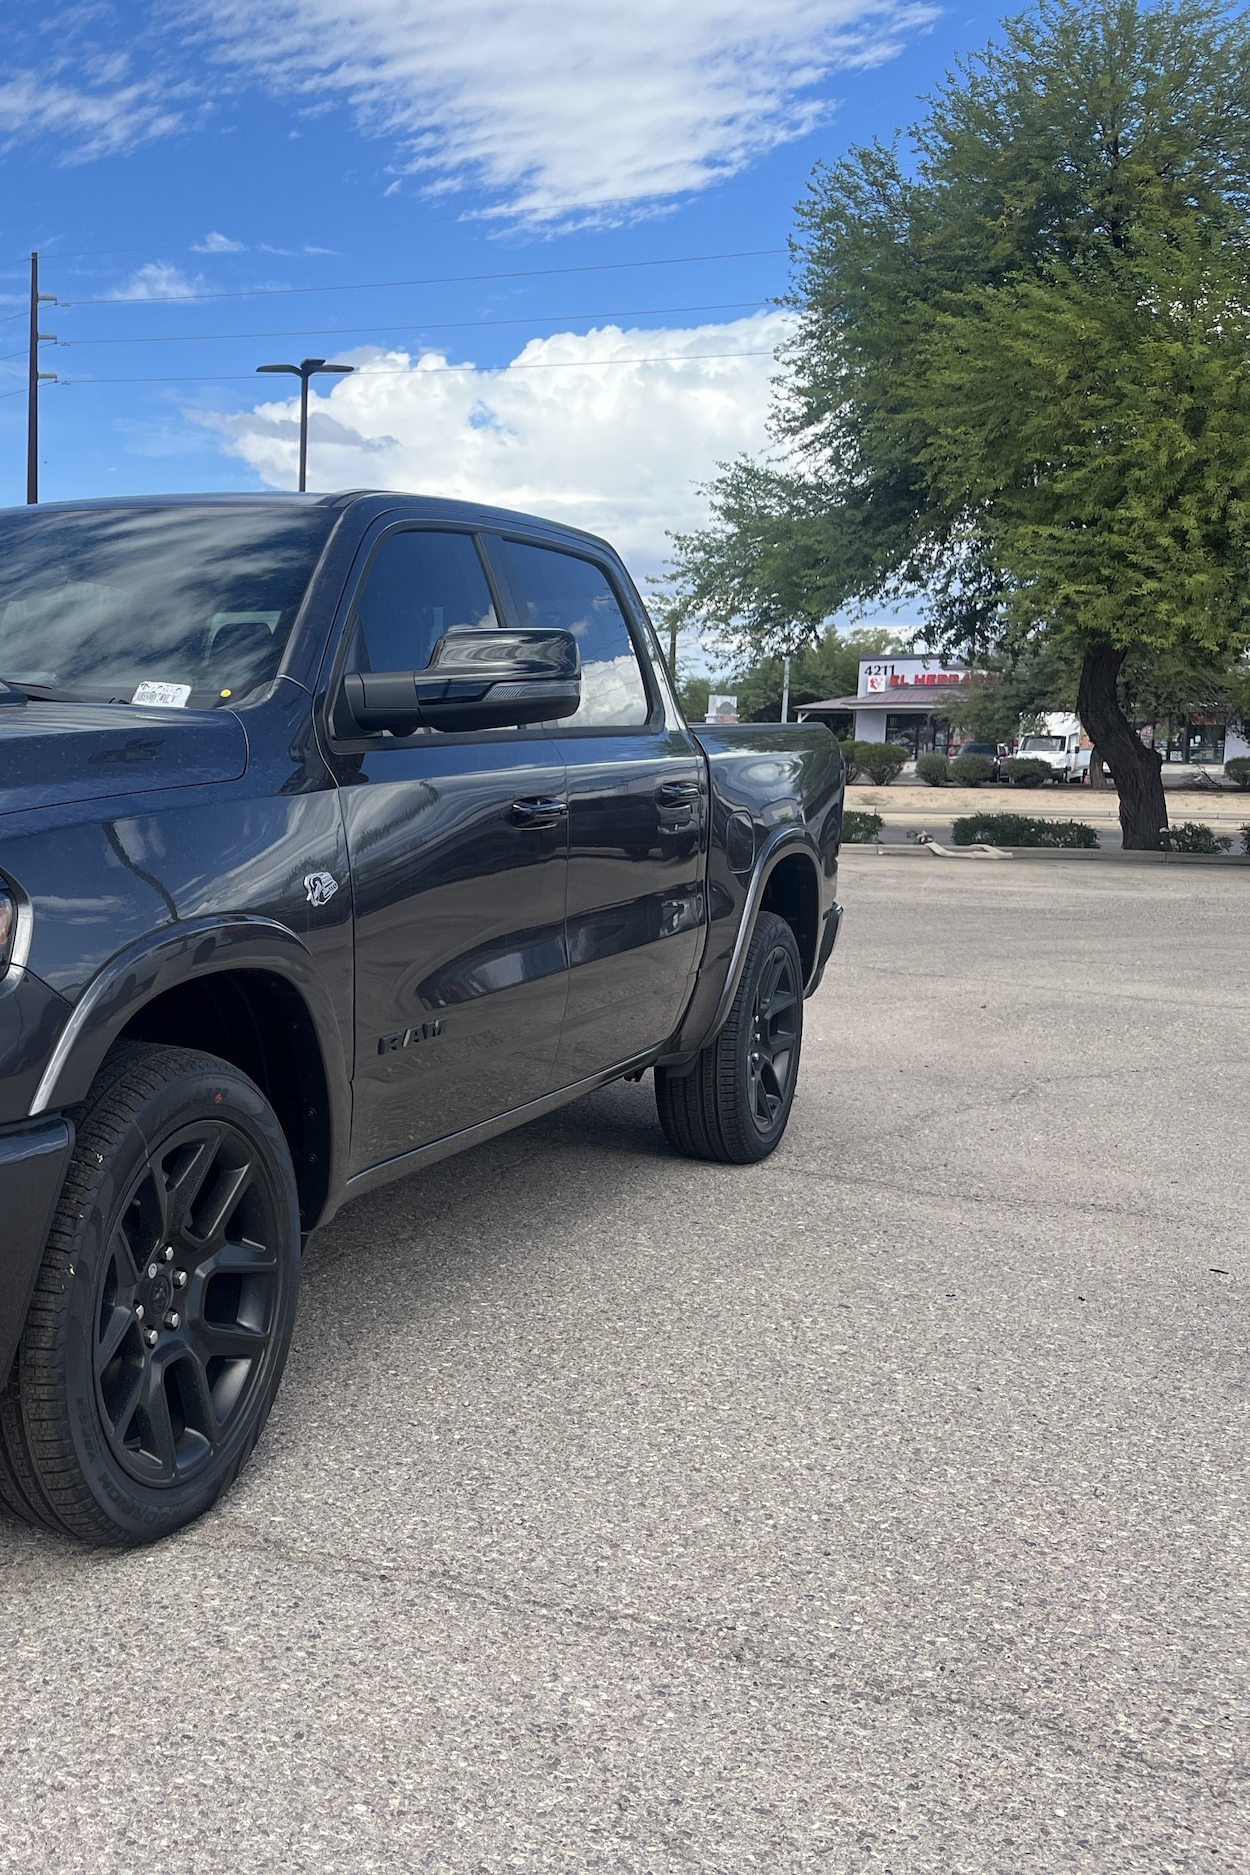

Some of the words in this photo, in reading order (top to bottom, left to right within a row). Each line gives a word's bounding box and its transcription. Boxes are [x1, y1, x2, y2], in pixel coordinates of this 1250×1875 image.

[864, 664, 895, 676] 4211
[890, 674, 909, 688] EL
[378, 1017, 446, 1055] RAM
